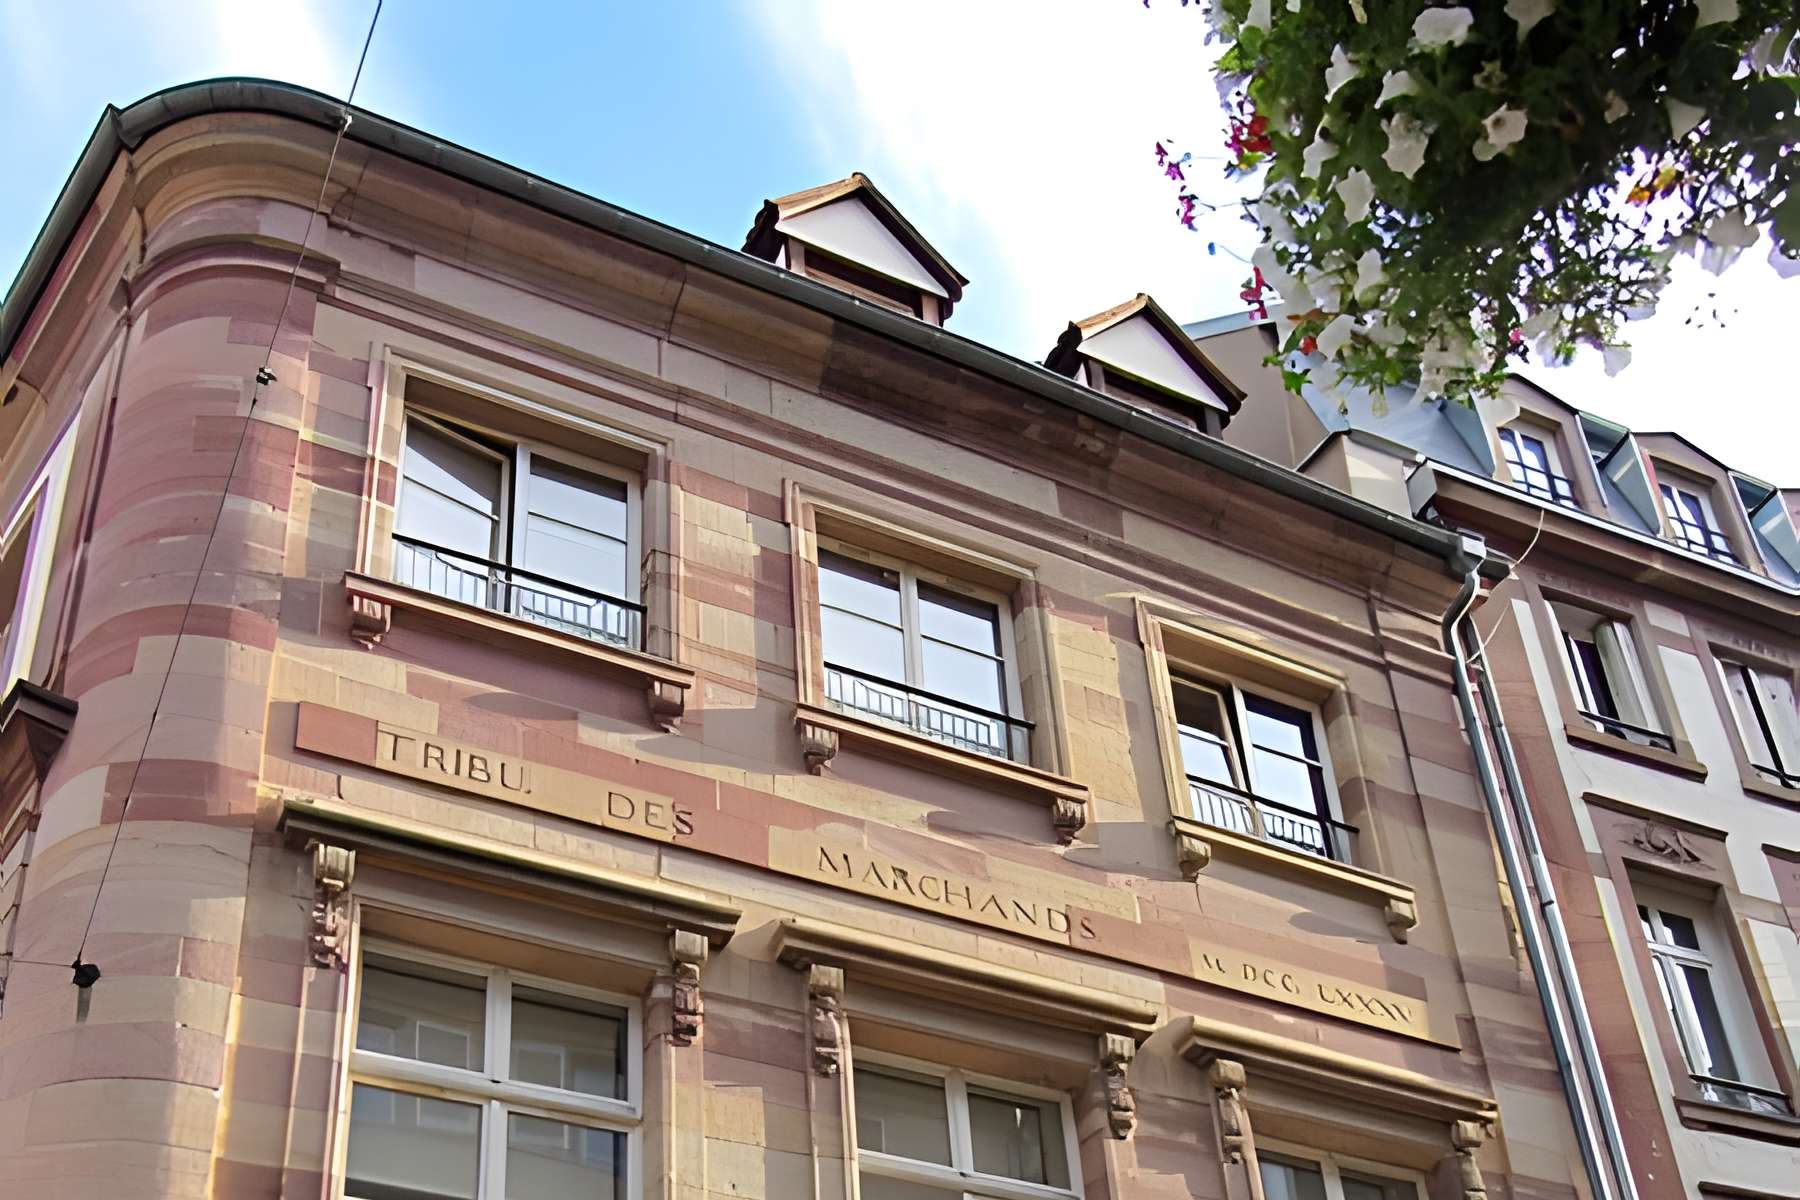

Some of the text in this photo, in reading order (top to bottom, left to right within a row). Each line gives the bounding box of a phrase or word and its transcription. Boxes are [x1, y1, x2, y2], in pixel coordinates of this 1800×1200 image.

[377, 729, 532, 794] TRIBU
[607, 790, 694, 837] DES
[818, 846, 1098, 940] MARCHANDS
